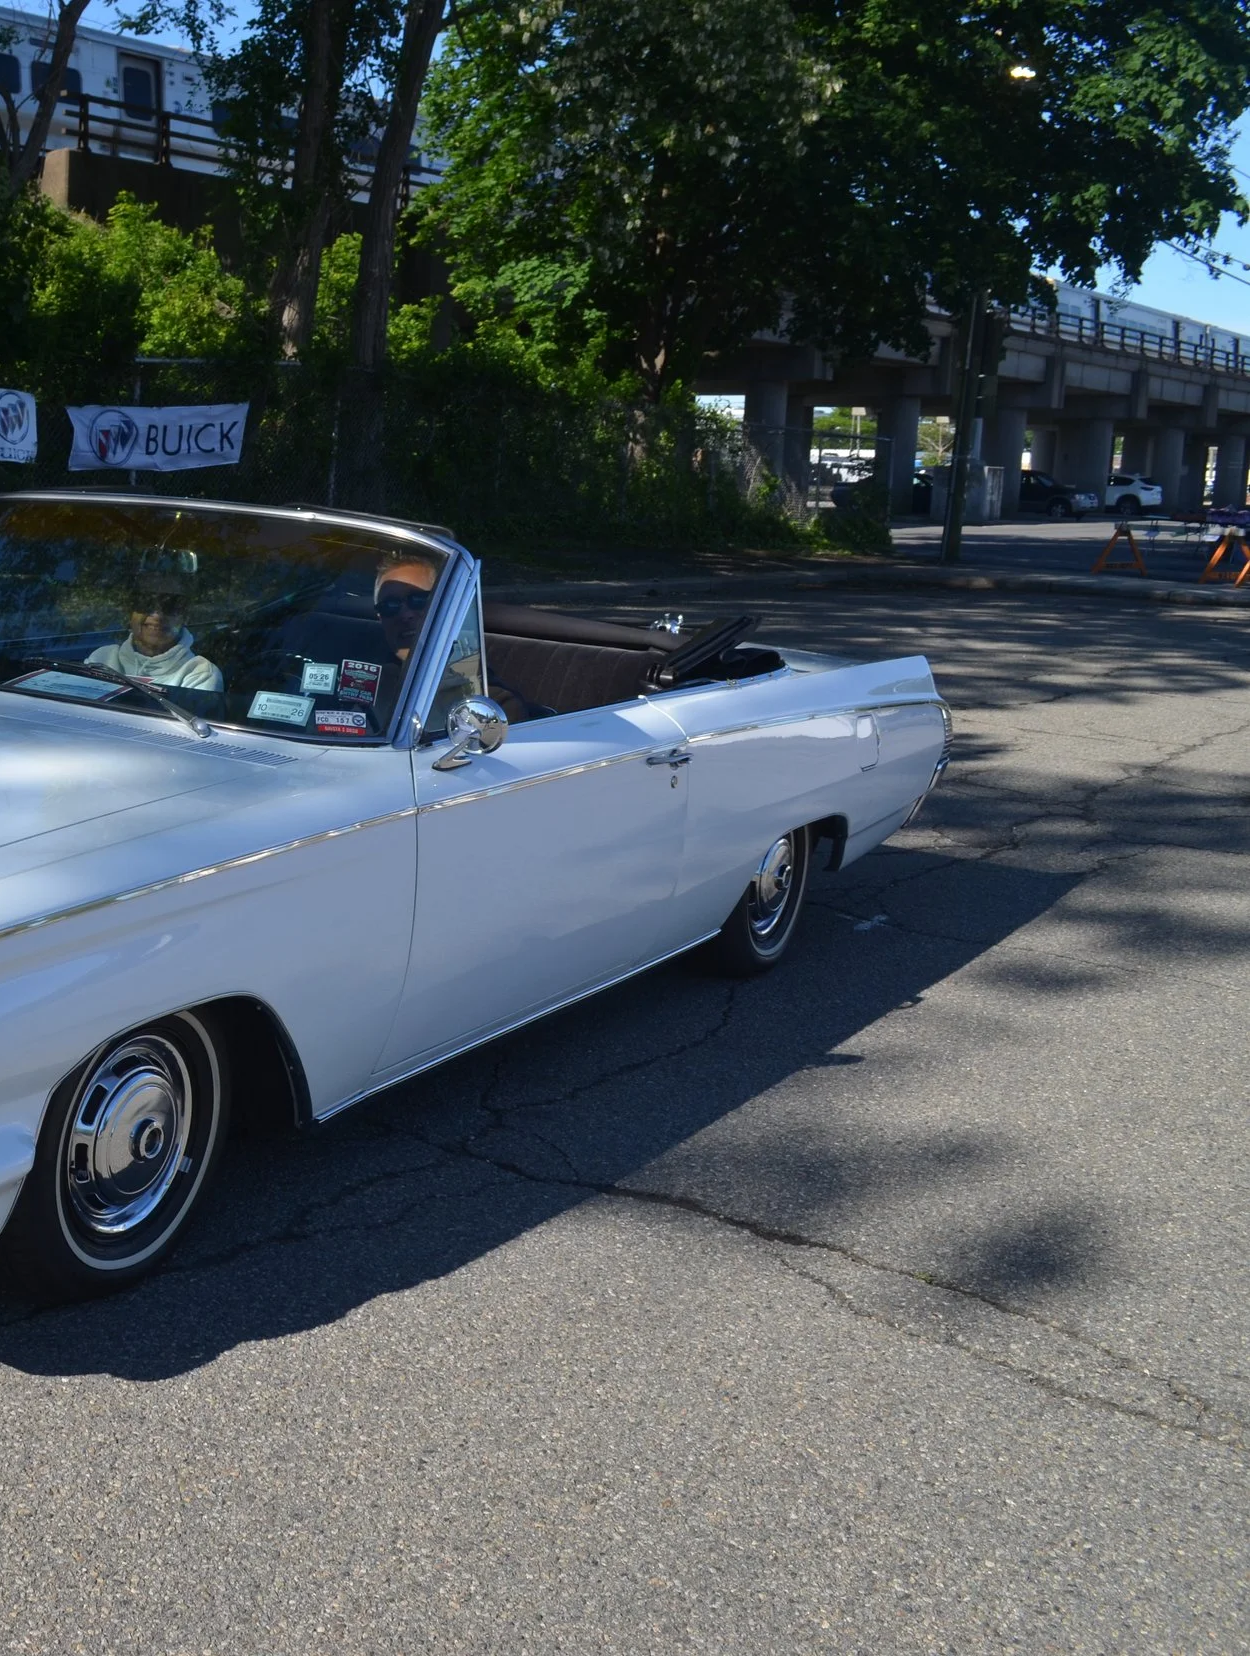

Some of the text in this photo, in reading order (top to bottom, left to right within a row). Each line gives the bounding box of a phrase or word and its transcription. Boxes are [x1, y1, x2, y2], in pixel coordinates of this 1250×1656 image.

[145, 421, 238, 455] BUICK
[347, 662, 377, 673] 2016
[257, 703, 268, 711] 10
[291, 708, 305, 717] 26
